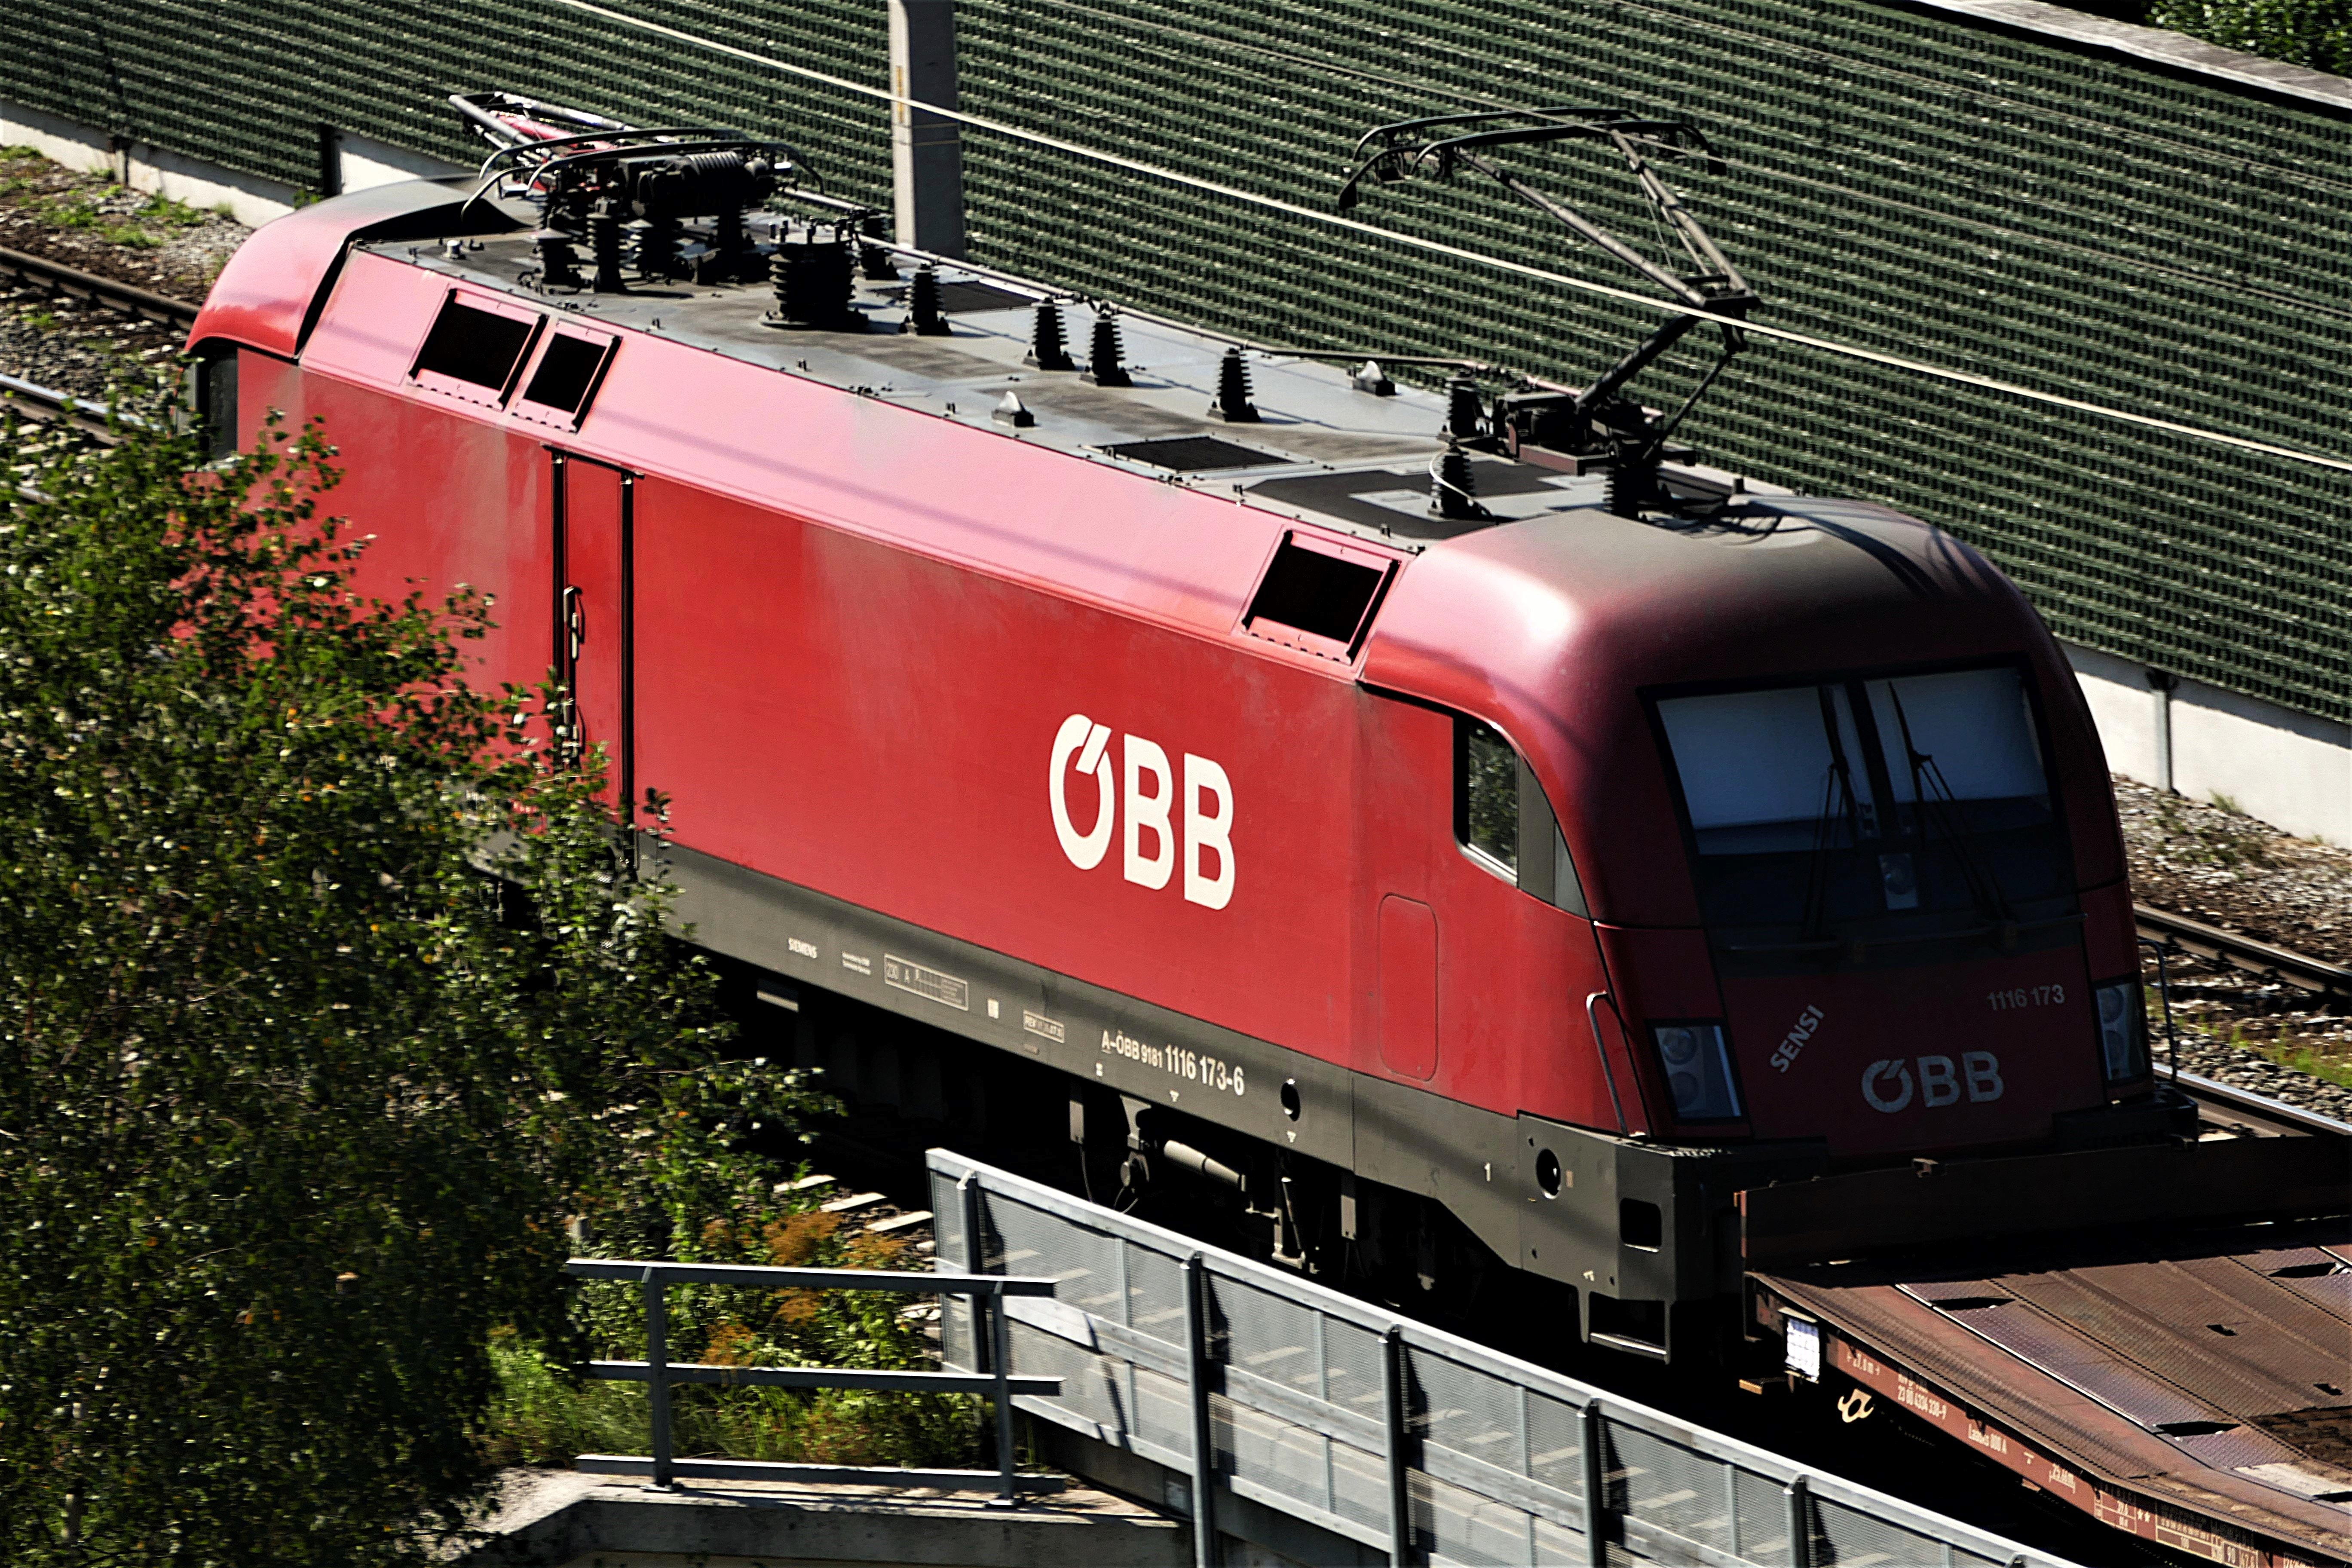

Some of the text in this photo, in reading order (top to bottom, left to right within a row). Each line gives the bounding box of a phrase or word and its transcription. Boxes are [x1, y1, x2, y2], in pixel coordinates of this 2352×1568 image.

[1049, 714, 1235, 910] ÖBB
[1986, 984, 2066, 1011] 1116 173
[1101, 1029, 1245, 1096] A-ÖBB 9181 1116 173-6
[1770, 1004, 1825, 1073] SENSI
[1862, 1051, 2004, 1113] ÖBB
